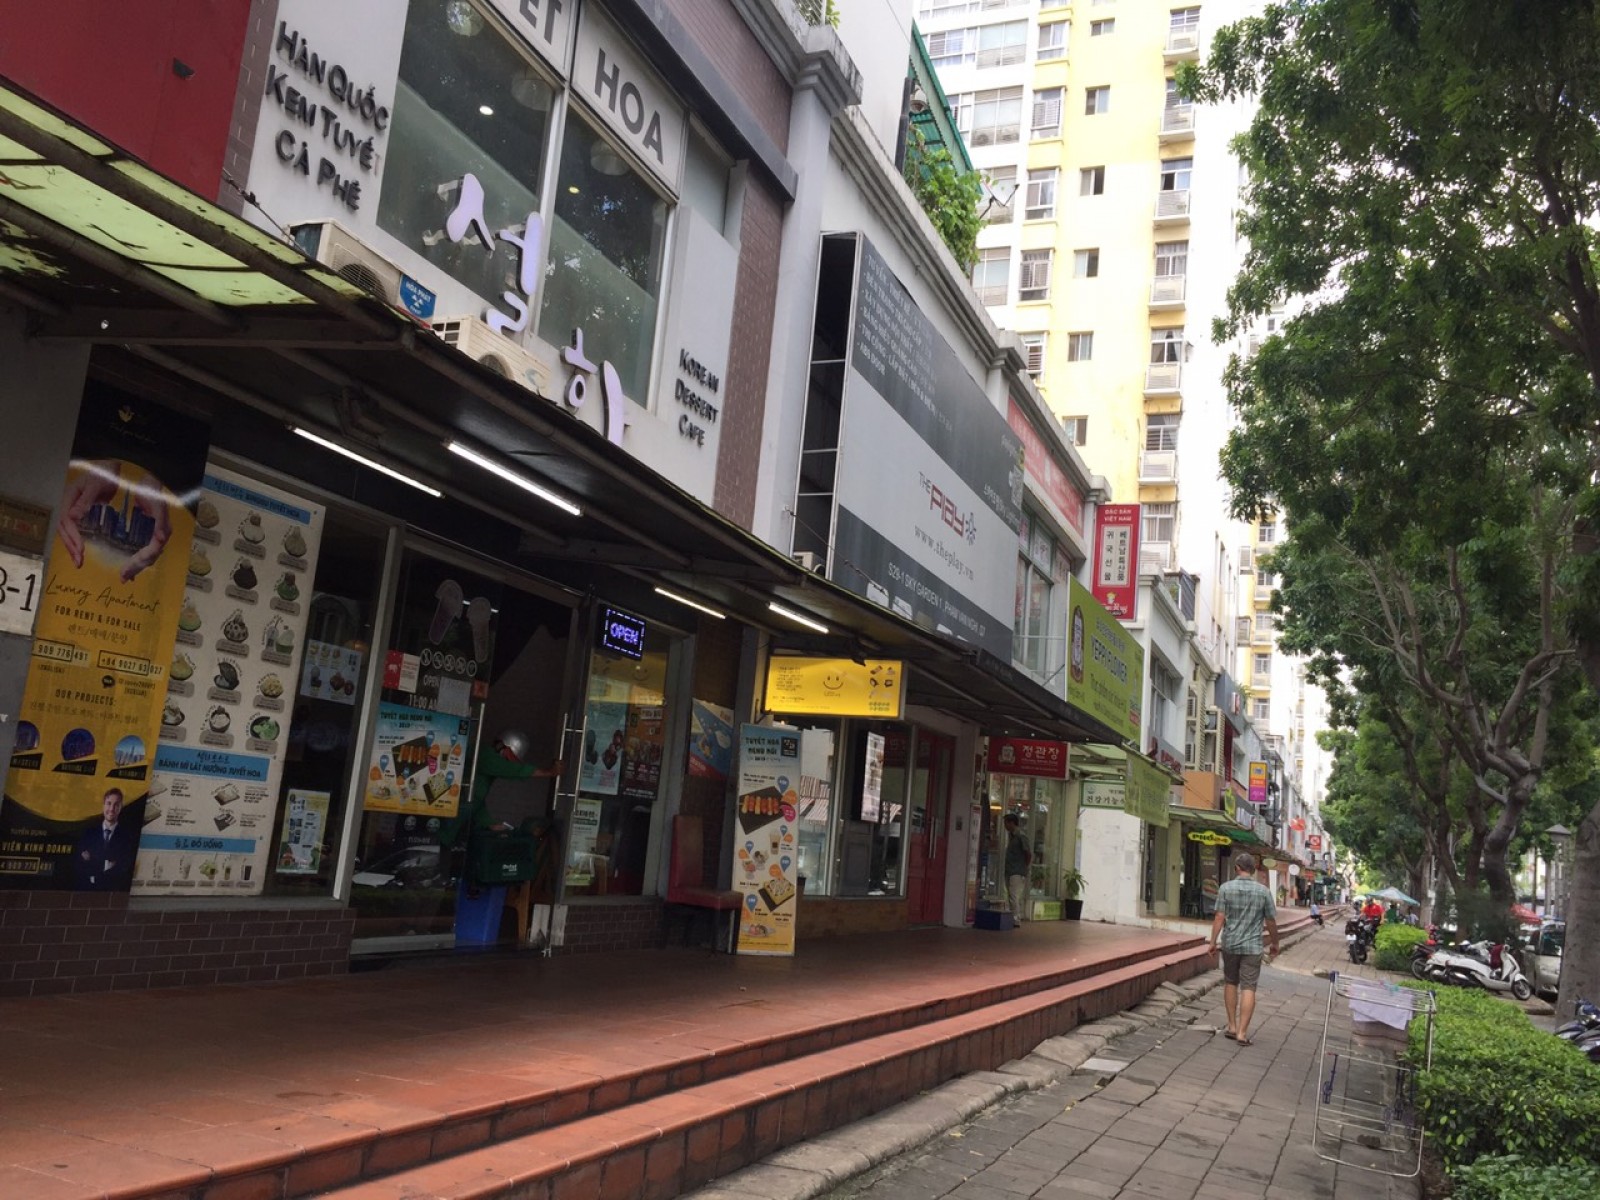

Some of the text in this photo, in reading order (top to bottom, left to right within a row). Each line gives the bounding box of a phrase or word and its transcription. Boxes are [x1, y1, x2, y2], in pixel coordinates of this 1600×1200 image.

[265, 65, 317, 127] KEM
[594, 47, 664, 165] HOA
[679, 348, 720, 394] KOREAN
[675, 378, 719, 424] DESSERT
[919, 471, 931, 495] THE
[45, 574, 161, 613] Luxury Apartment
[916, 580, 940, 608] GARDEN
[54, 604, 71, 617] FOR
[73, 609, 96, 623] RENT
[105, 616, 121, 627] FOR
[123, 620, 142, 632] SALE
[610, 622, 639, 645] OPEN
[55, 689, 71, 700] OUR
[1022, 745, 1059, 760] 정관장
